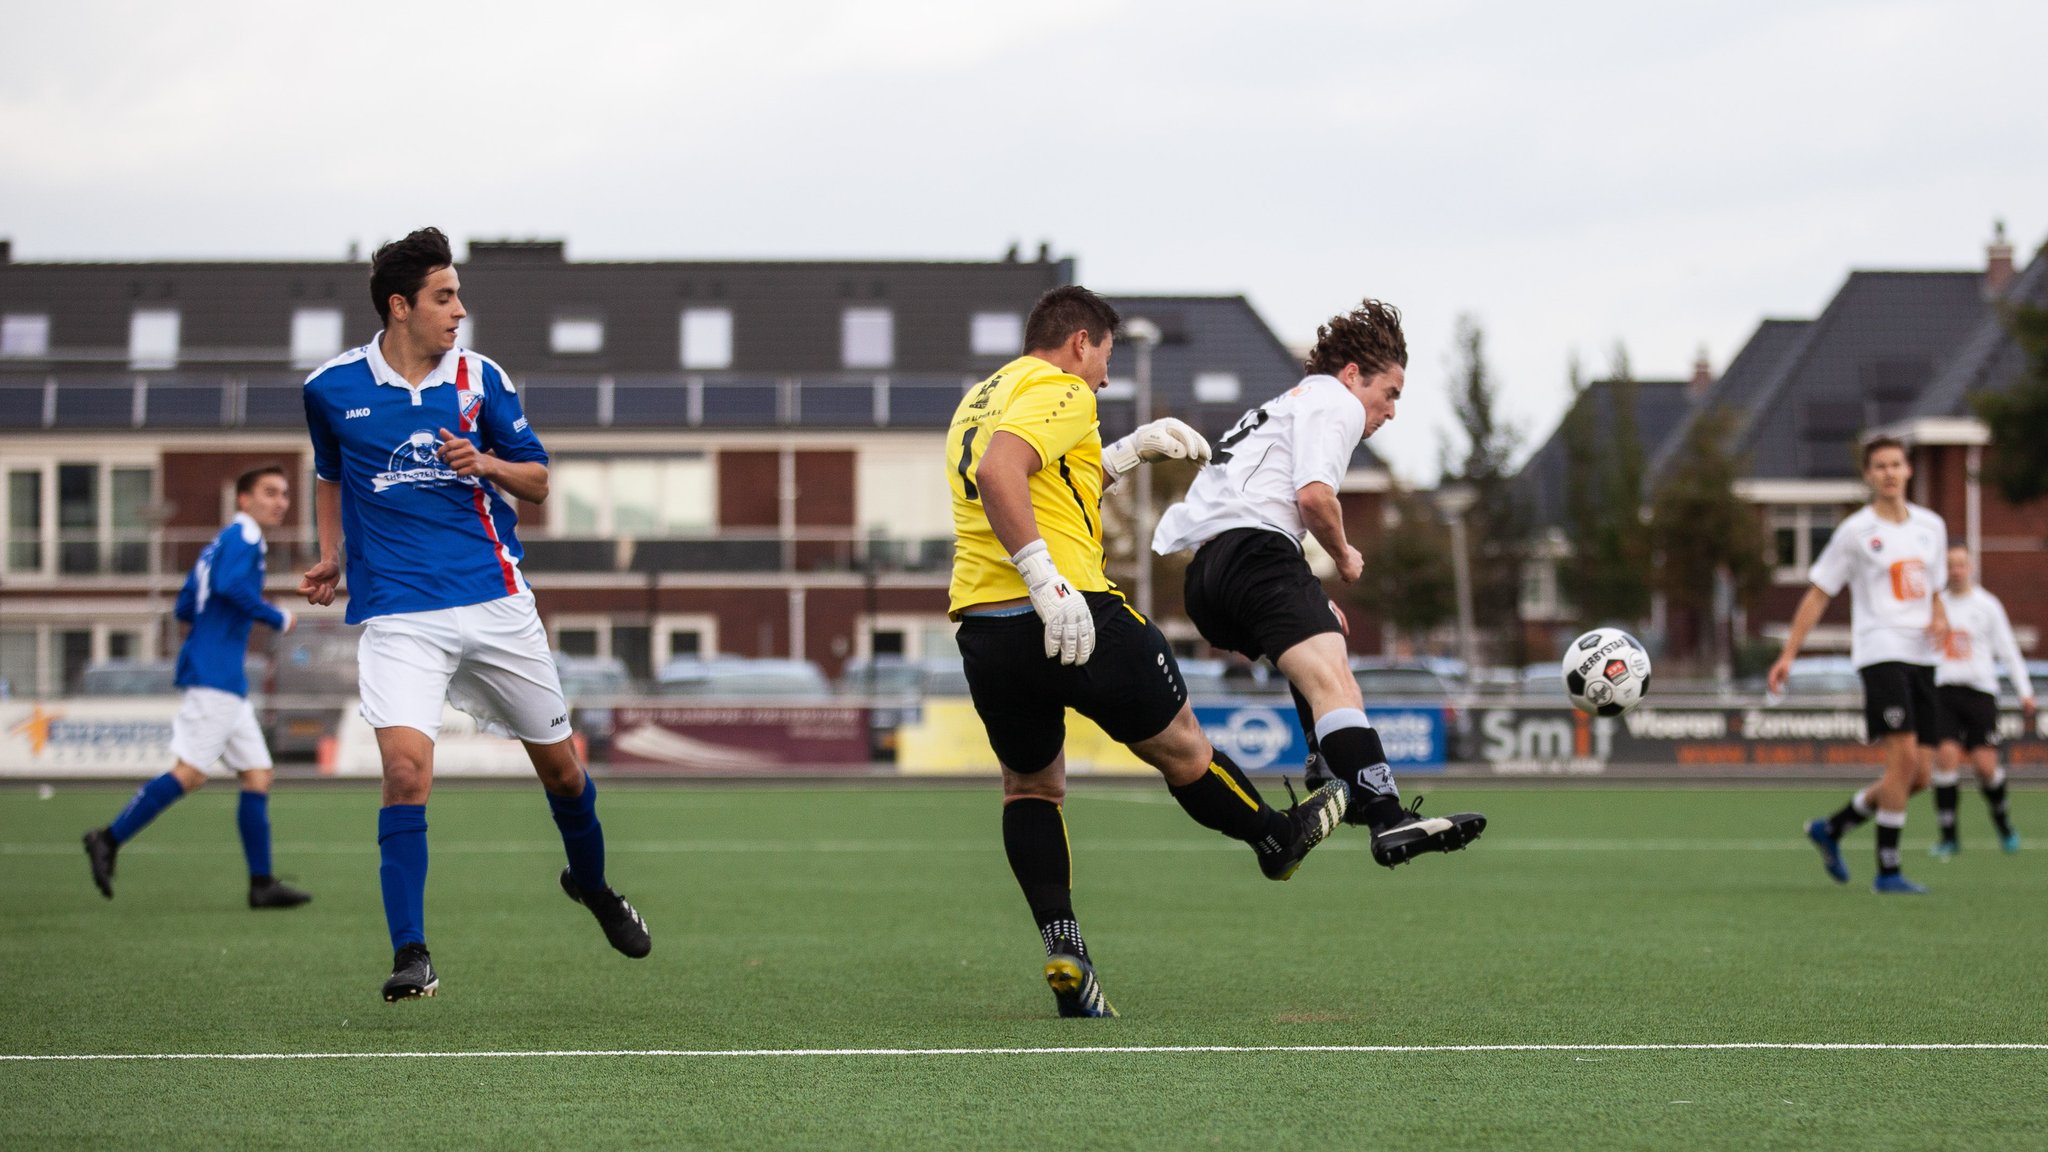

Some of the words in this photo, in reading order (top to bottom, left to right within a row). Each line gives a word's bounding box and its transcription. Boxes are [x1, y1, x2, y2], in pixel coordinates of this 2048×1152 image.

[345, 407, 371, 420] JAKO
[958, 426, 979, 501] 1
[1481, 709, 1617, 760] Smit
